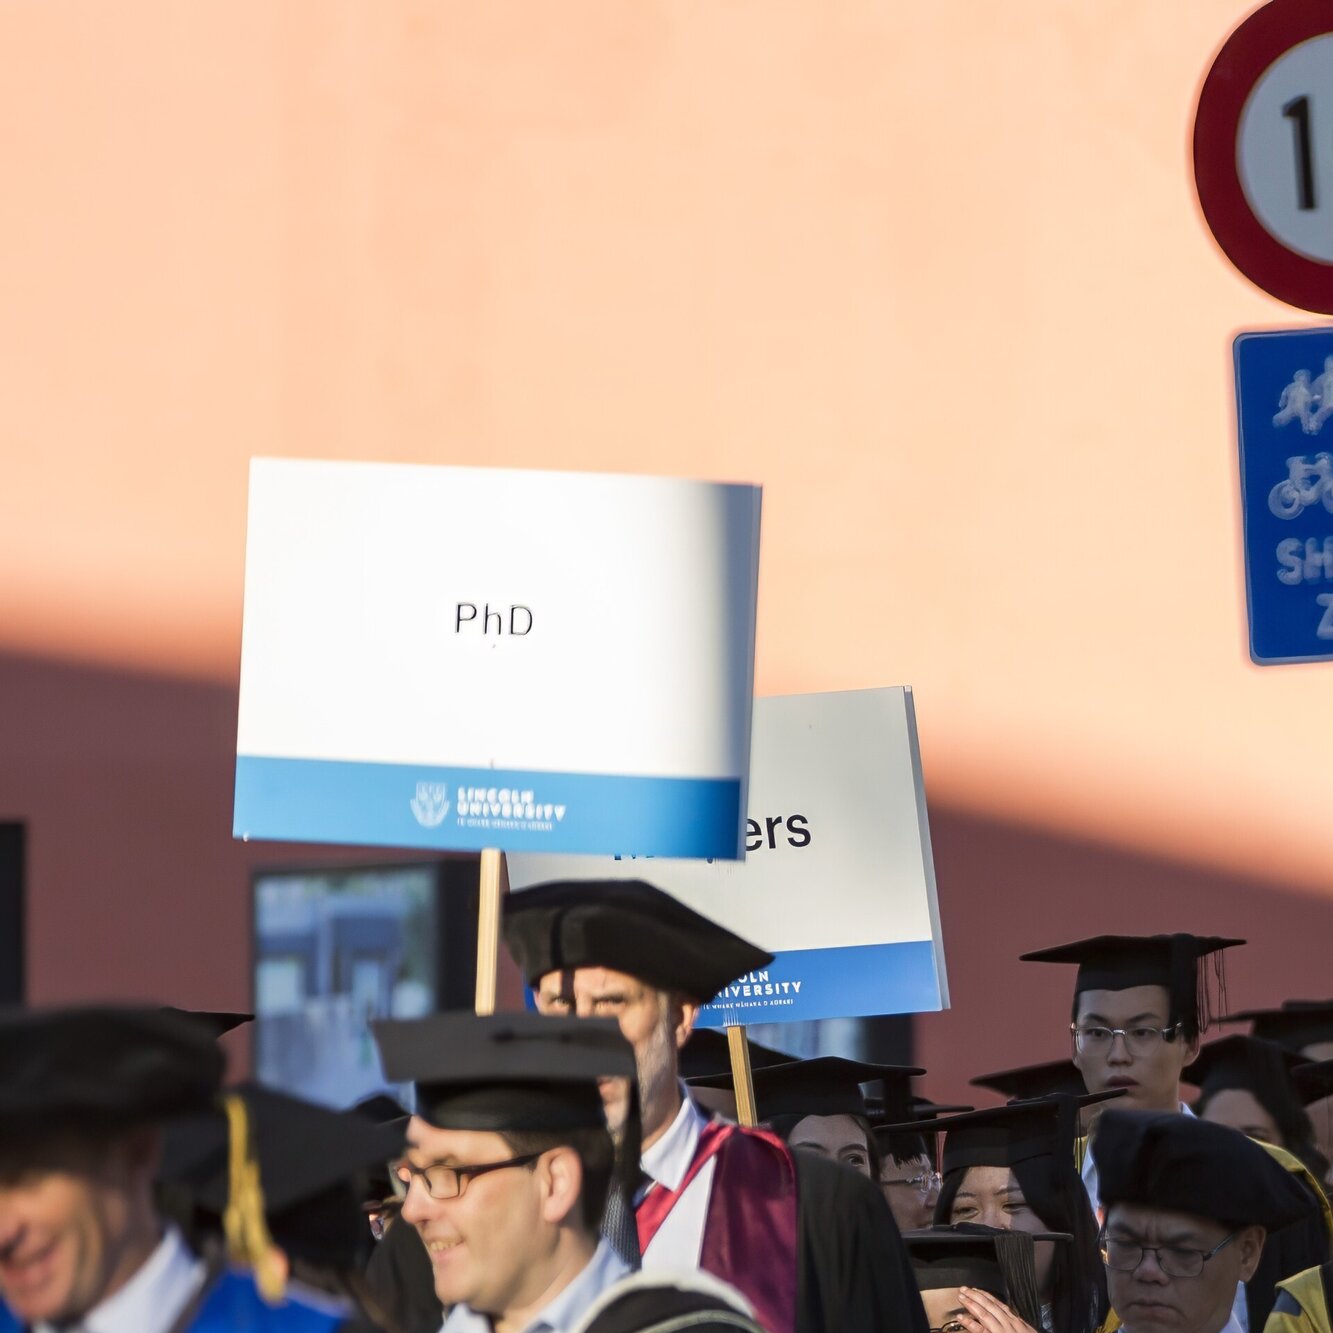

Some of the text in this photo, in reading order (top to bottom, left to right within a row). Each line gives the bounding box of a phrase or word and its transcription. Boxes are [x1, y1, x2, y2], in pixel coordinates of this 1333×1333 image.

[456, 603, 533, 635] PhD
[457, 786, 534, 804] LINCOLN
[457, 801, 566, 822] UNIVERSITY
[718, 981, 801, 998] IVERSITY
